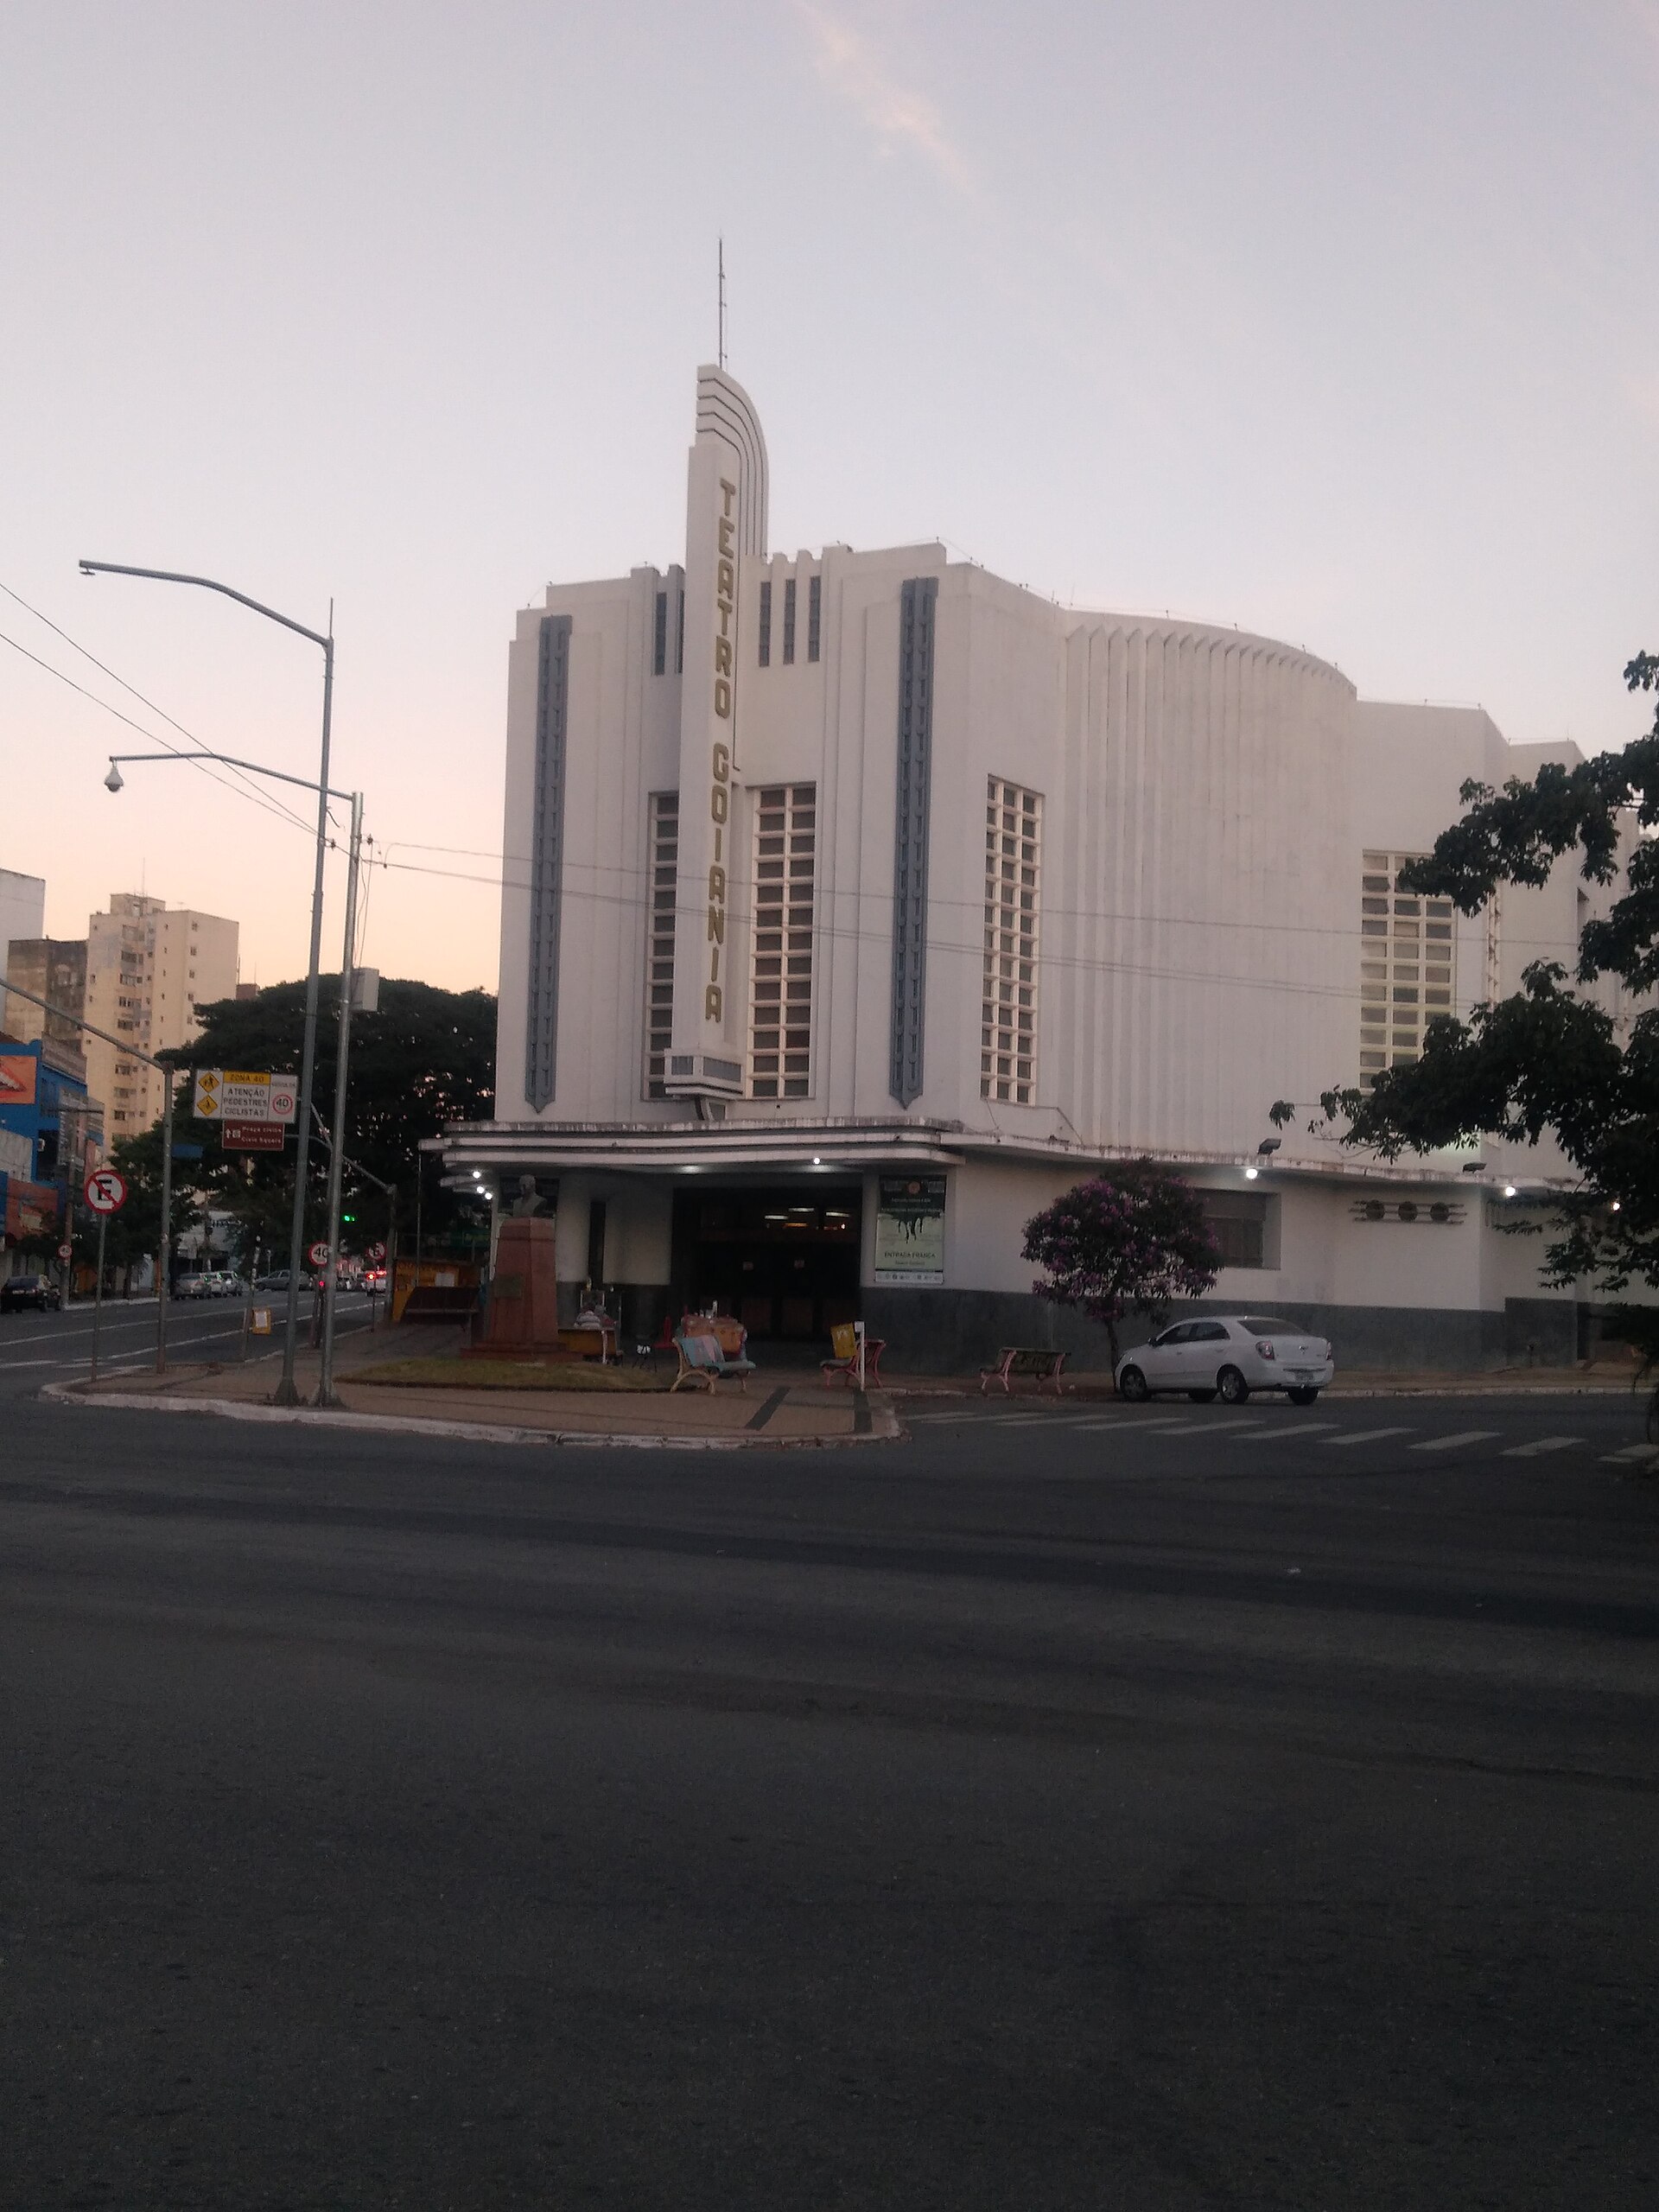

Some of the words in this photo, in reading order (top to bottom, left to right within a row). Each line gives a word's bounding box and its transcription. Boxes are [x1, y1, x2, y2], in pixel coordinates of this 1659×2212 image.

[714, 477, 736, 720] TEATRO
[705, 741, 729, 1024] GOIANIA
[227, 1087, 265, 1097] ATENÇÃO
[223, 1097, 267, 1107] PEDESTRES
[276, 1098, 289, 1108] 40
[224, 1107, 264, 1116] CICLISTAS
